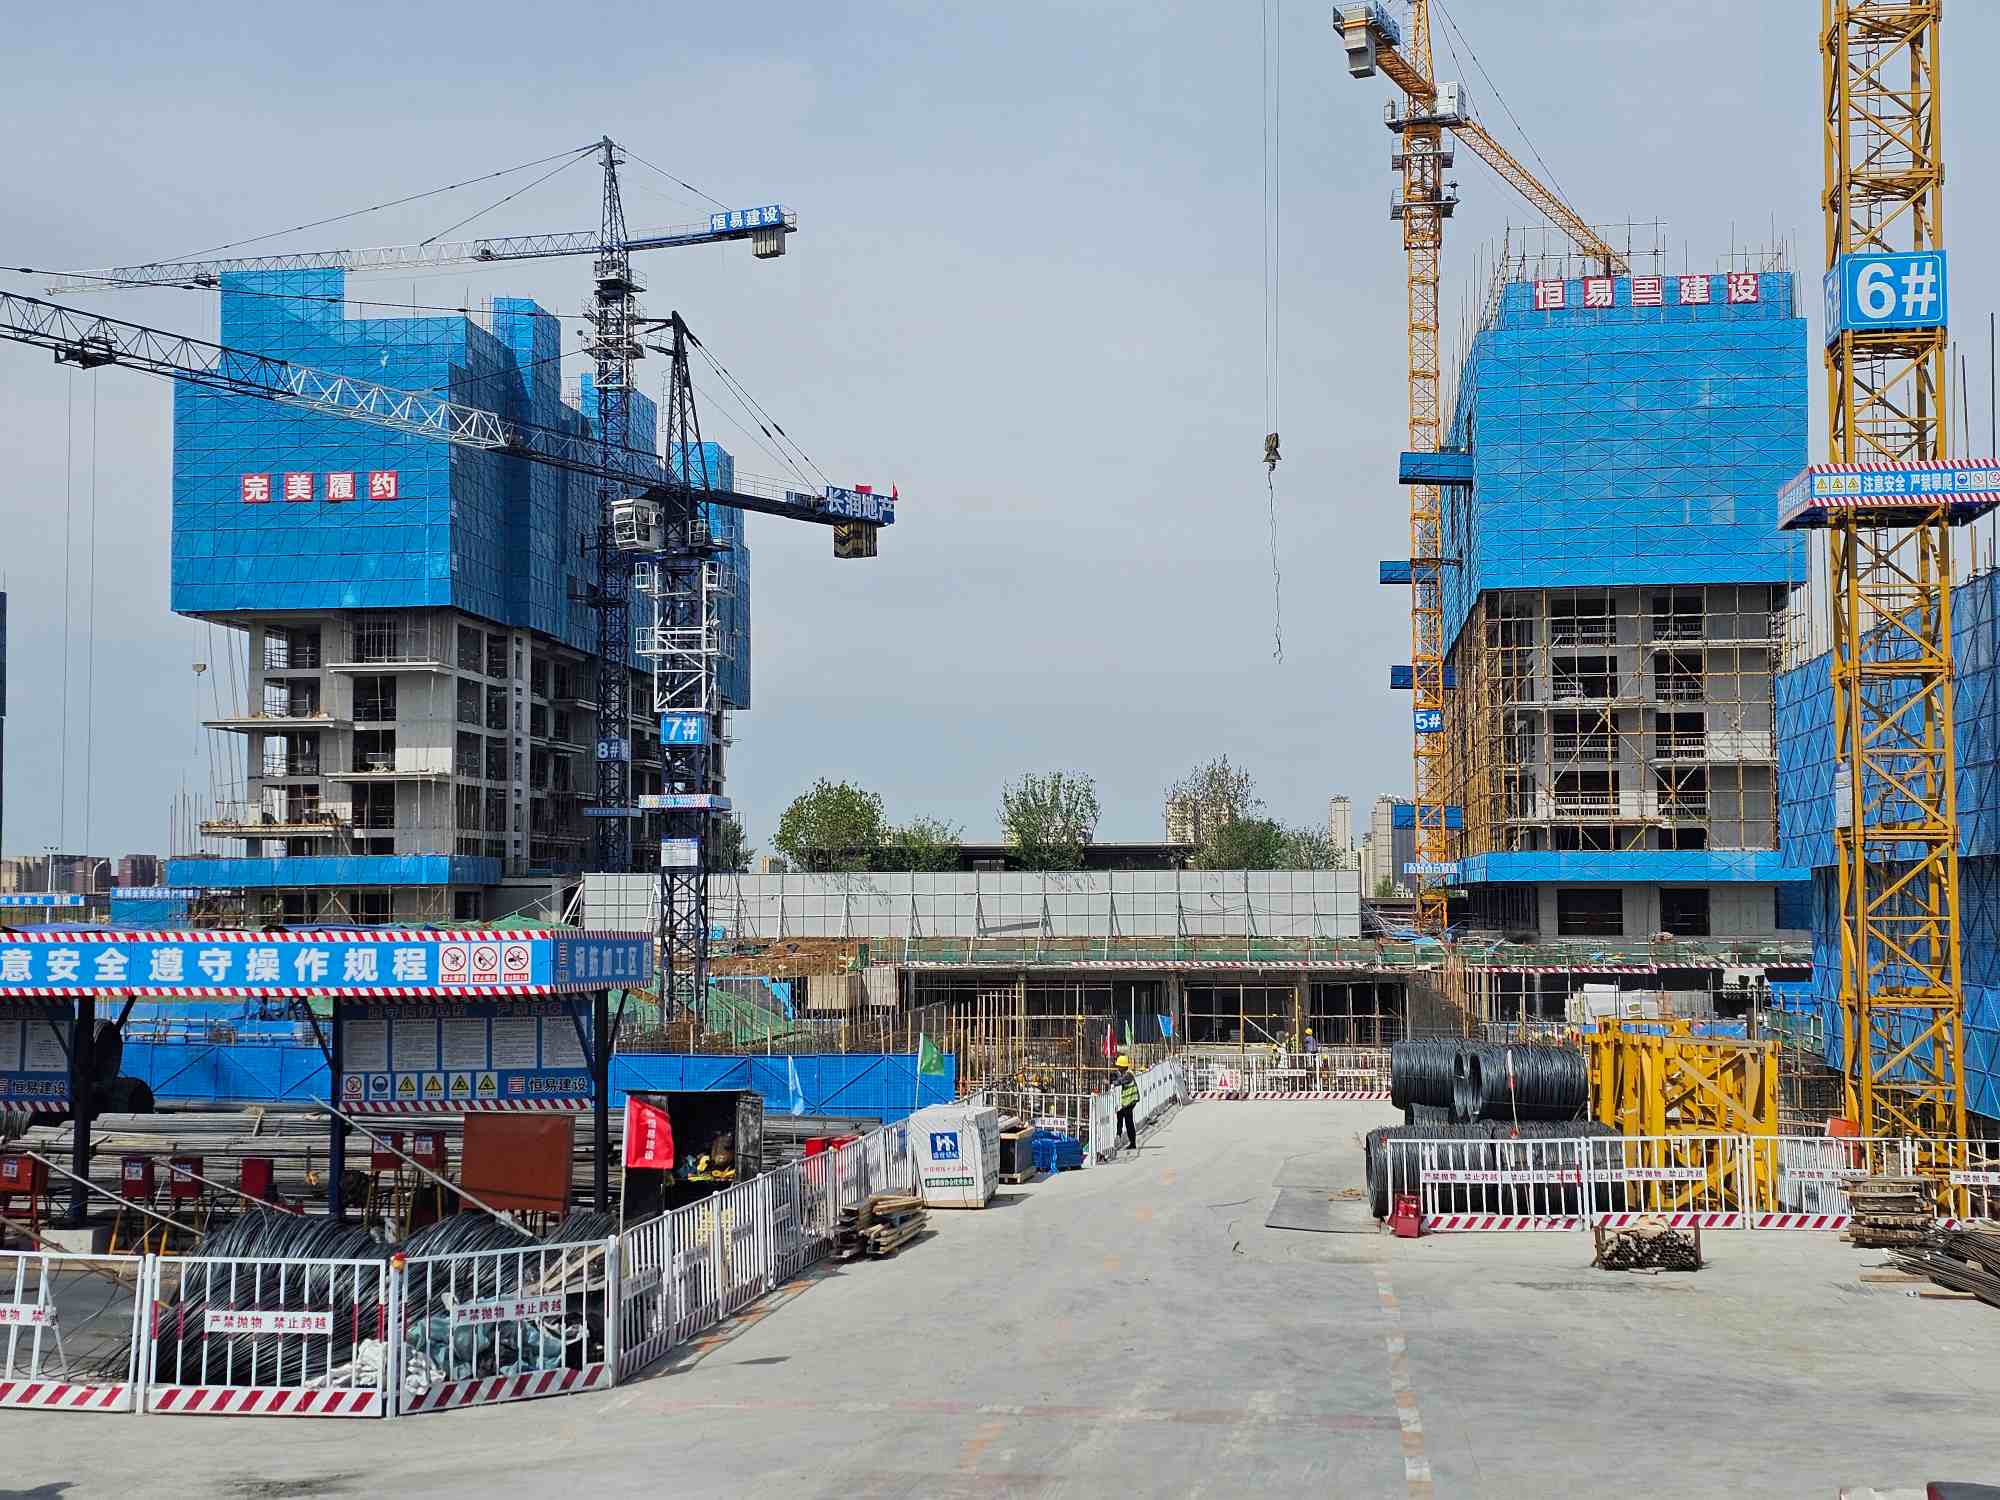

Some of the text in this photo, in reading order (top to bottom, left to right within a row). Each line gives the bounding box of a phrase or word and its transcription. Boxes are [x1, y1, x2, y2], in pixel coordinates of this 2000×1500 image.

[712, 207, 778, 230] 恒易建设
[1857, 262, 1937, 319] 6#
[244, 473, 397, 501] 完美履约
[1863, 474, 1906, 493] 注意安全
[827, 487, 894, 520] 长润地产
[666, 717, 698, 741] 7#
[1415, 713, 1441, 730] 5#
[598, 741, 620, 759] 8#
[0, 947, 428, 983] 意安全 遵守操作规程
[575, 945, 638, 978] 钢筋加工区
[527, 1075, 589, 1093] 恒易建设
[456, 1297, 564, 1322] 严禁抛物 禁止跨越
[209, 1315, 327, 1330] 严禁抛物 禁止跨越
